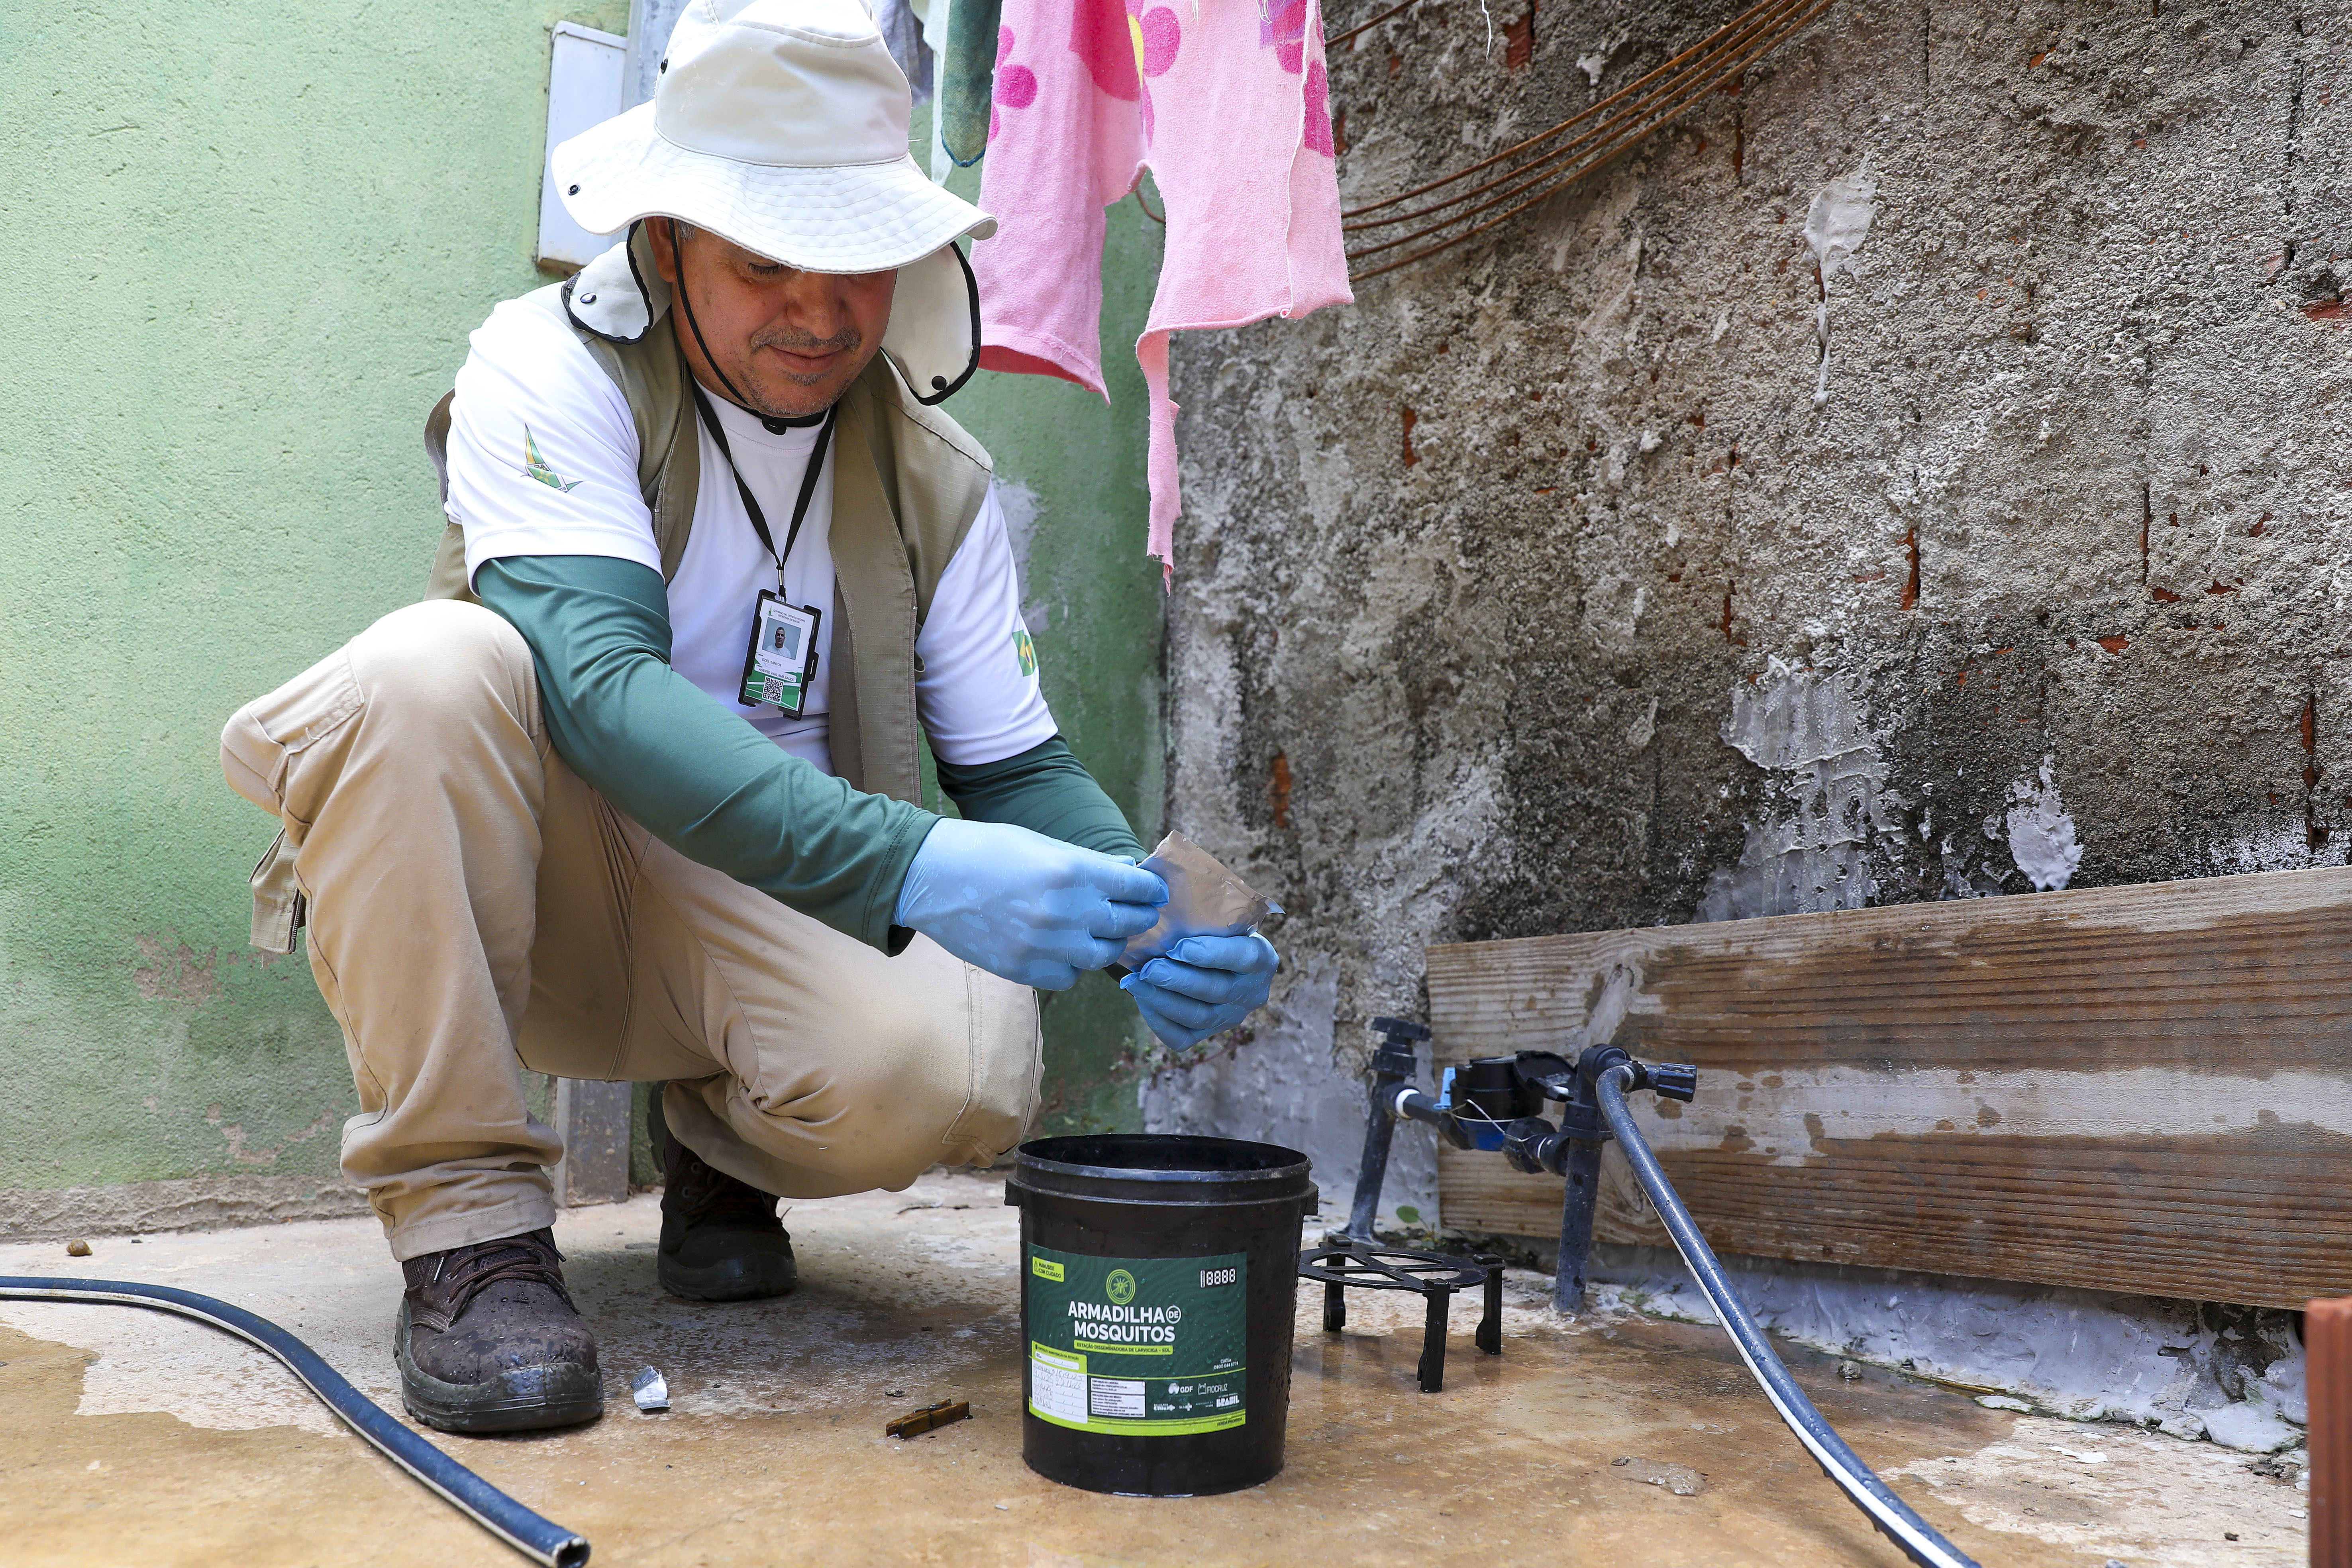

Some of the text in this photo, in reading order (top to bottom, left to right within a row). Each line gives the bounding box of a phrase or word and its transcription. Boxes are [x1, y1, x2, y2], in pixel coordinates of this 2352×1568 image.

[1067, 1301, 1179, 1323] ARMADILHA DE
[1074, 1320, 1175, 1343] MOSQUITOS
[1207, 1383, 1228, 1394] FIOCRUZ
[1216, 1395, 1240, 1408] BRASIL
